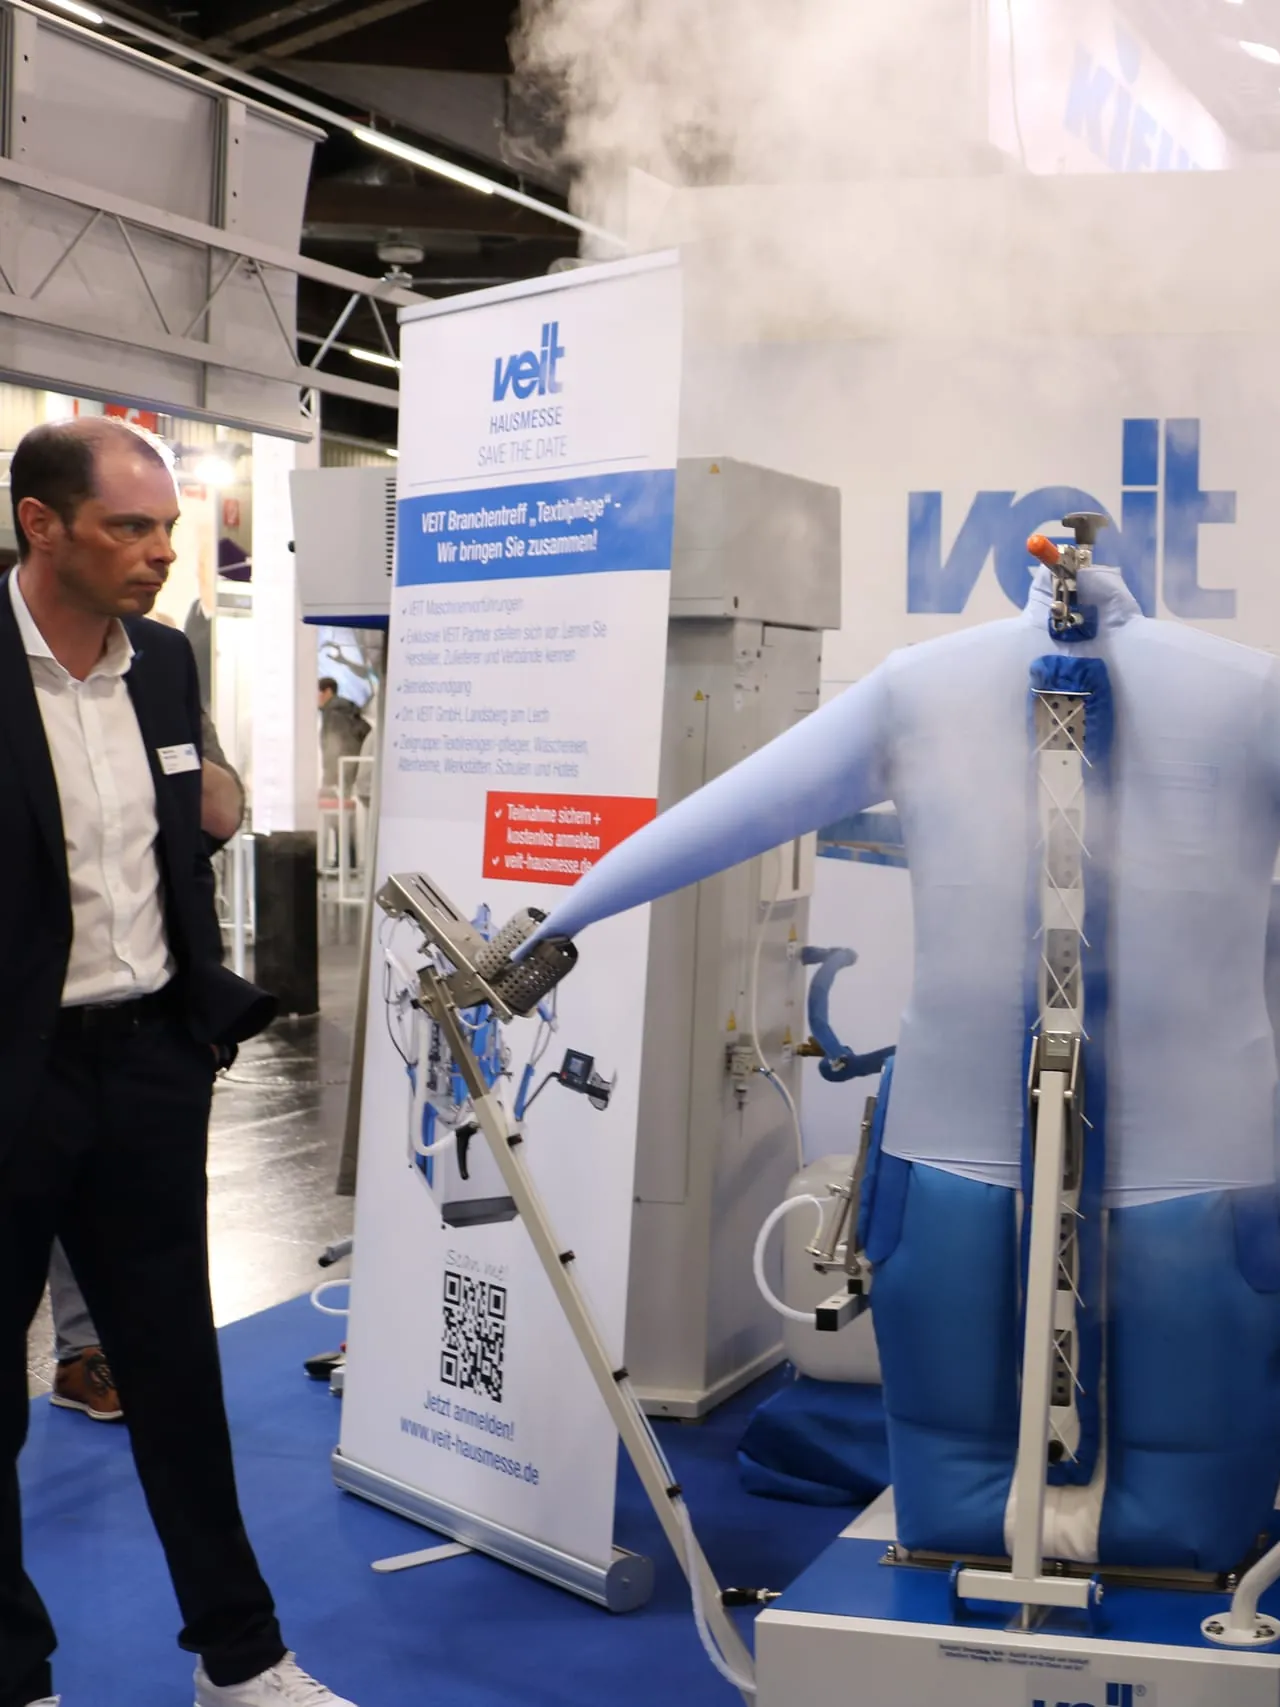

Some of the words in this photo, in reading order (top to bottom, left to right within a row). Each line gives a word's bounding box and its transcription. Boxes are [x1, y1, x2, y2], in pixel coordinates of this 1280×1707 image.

[493, 321, 565, 401] veit
[489, 406, 563, 434] HAUSMESSE
[477, 442, 506, 467] SAVE
[510, 439, 532, 462] THE
[536, 435, 568, 460] DATE
[421, 511, 446, 534] VEIT
[448, 502, 528, 531] Branchentreff
[906, 418, 1237, 619] veit
[437, 542, 457, 563] Wir
[459, 538, 503, 565] bringen
[505, 535, 525, 559] Sie
[527, 528, 598, 556] zusammen!
[507, 803, 556, 823] Teilnahme
[558, 806, 592, 825] sichern
[555, 832, 600, 850] anmelden
[423, 1391, 451, 1418] Jetzt
[453, 1402, 515, 1441] anmelden!
[400, 1416, 540, 1486] www.veit-hausmesse.de
